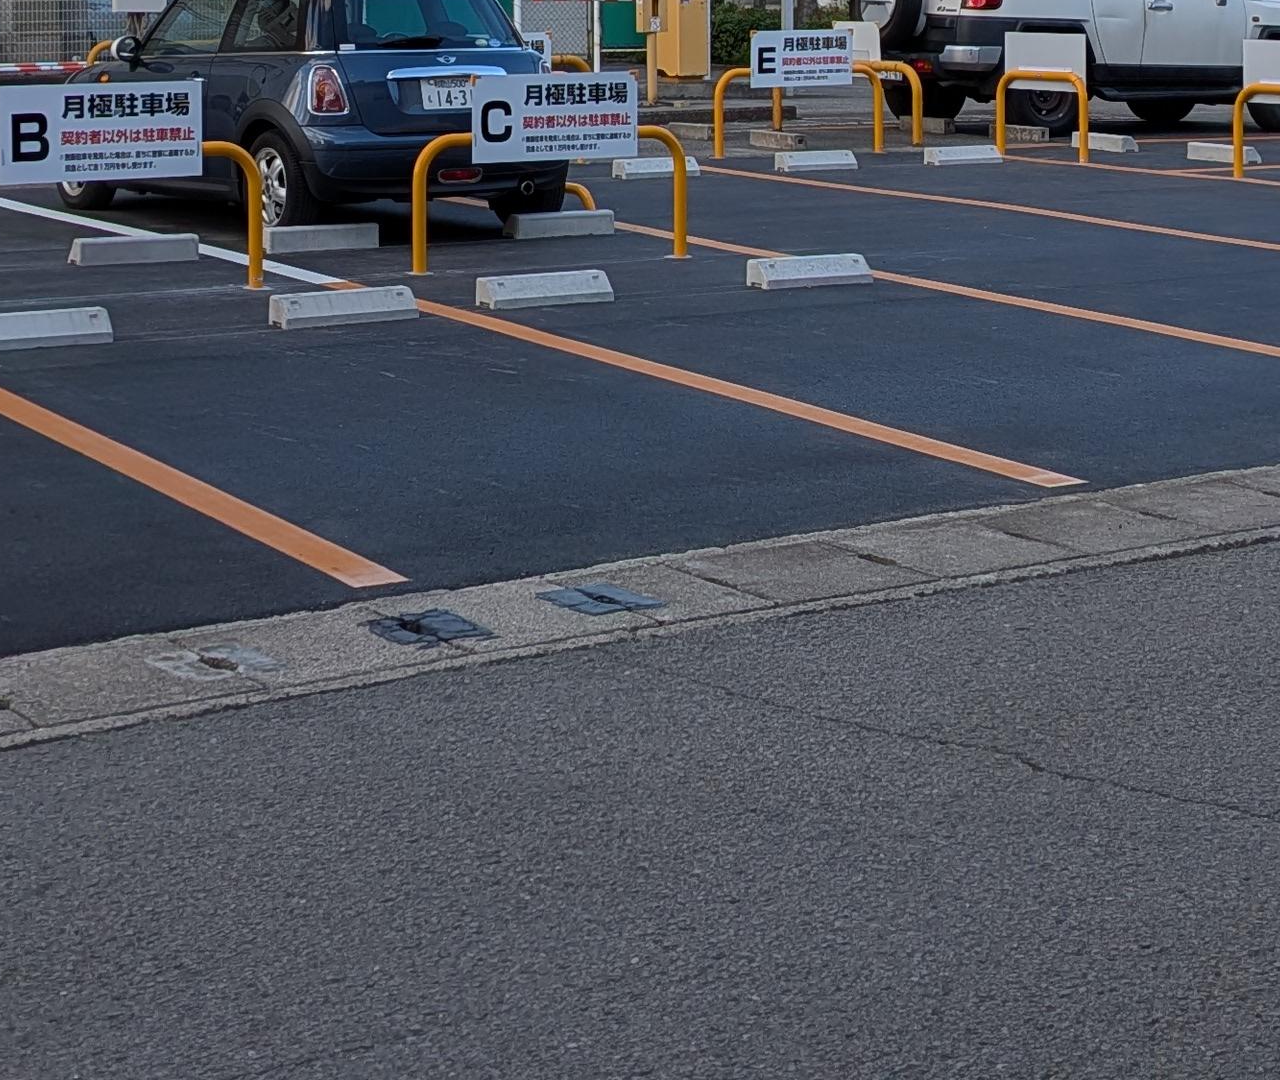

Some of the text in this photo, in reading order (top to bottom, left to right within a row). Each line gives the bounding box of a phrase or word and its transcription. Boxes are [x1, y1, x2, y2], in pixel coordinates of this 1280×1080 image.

[783, 36, 847, 52] 月極駐車場
[757, 46, 777, 74] E
[61, 92, 190, 120] 月極駐車場
[523, 82, 628, 107] 月極駐車場
[481, 100, 513, 143] C
[522, 111, 632, 130] 契約者以外は駐車禁止
[11, 112, 50, 163] B
[60, 126, 196, 146] 契約者以外は駐車禁止
